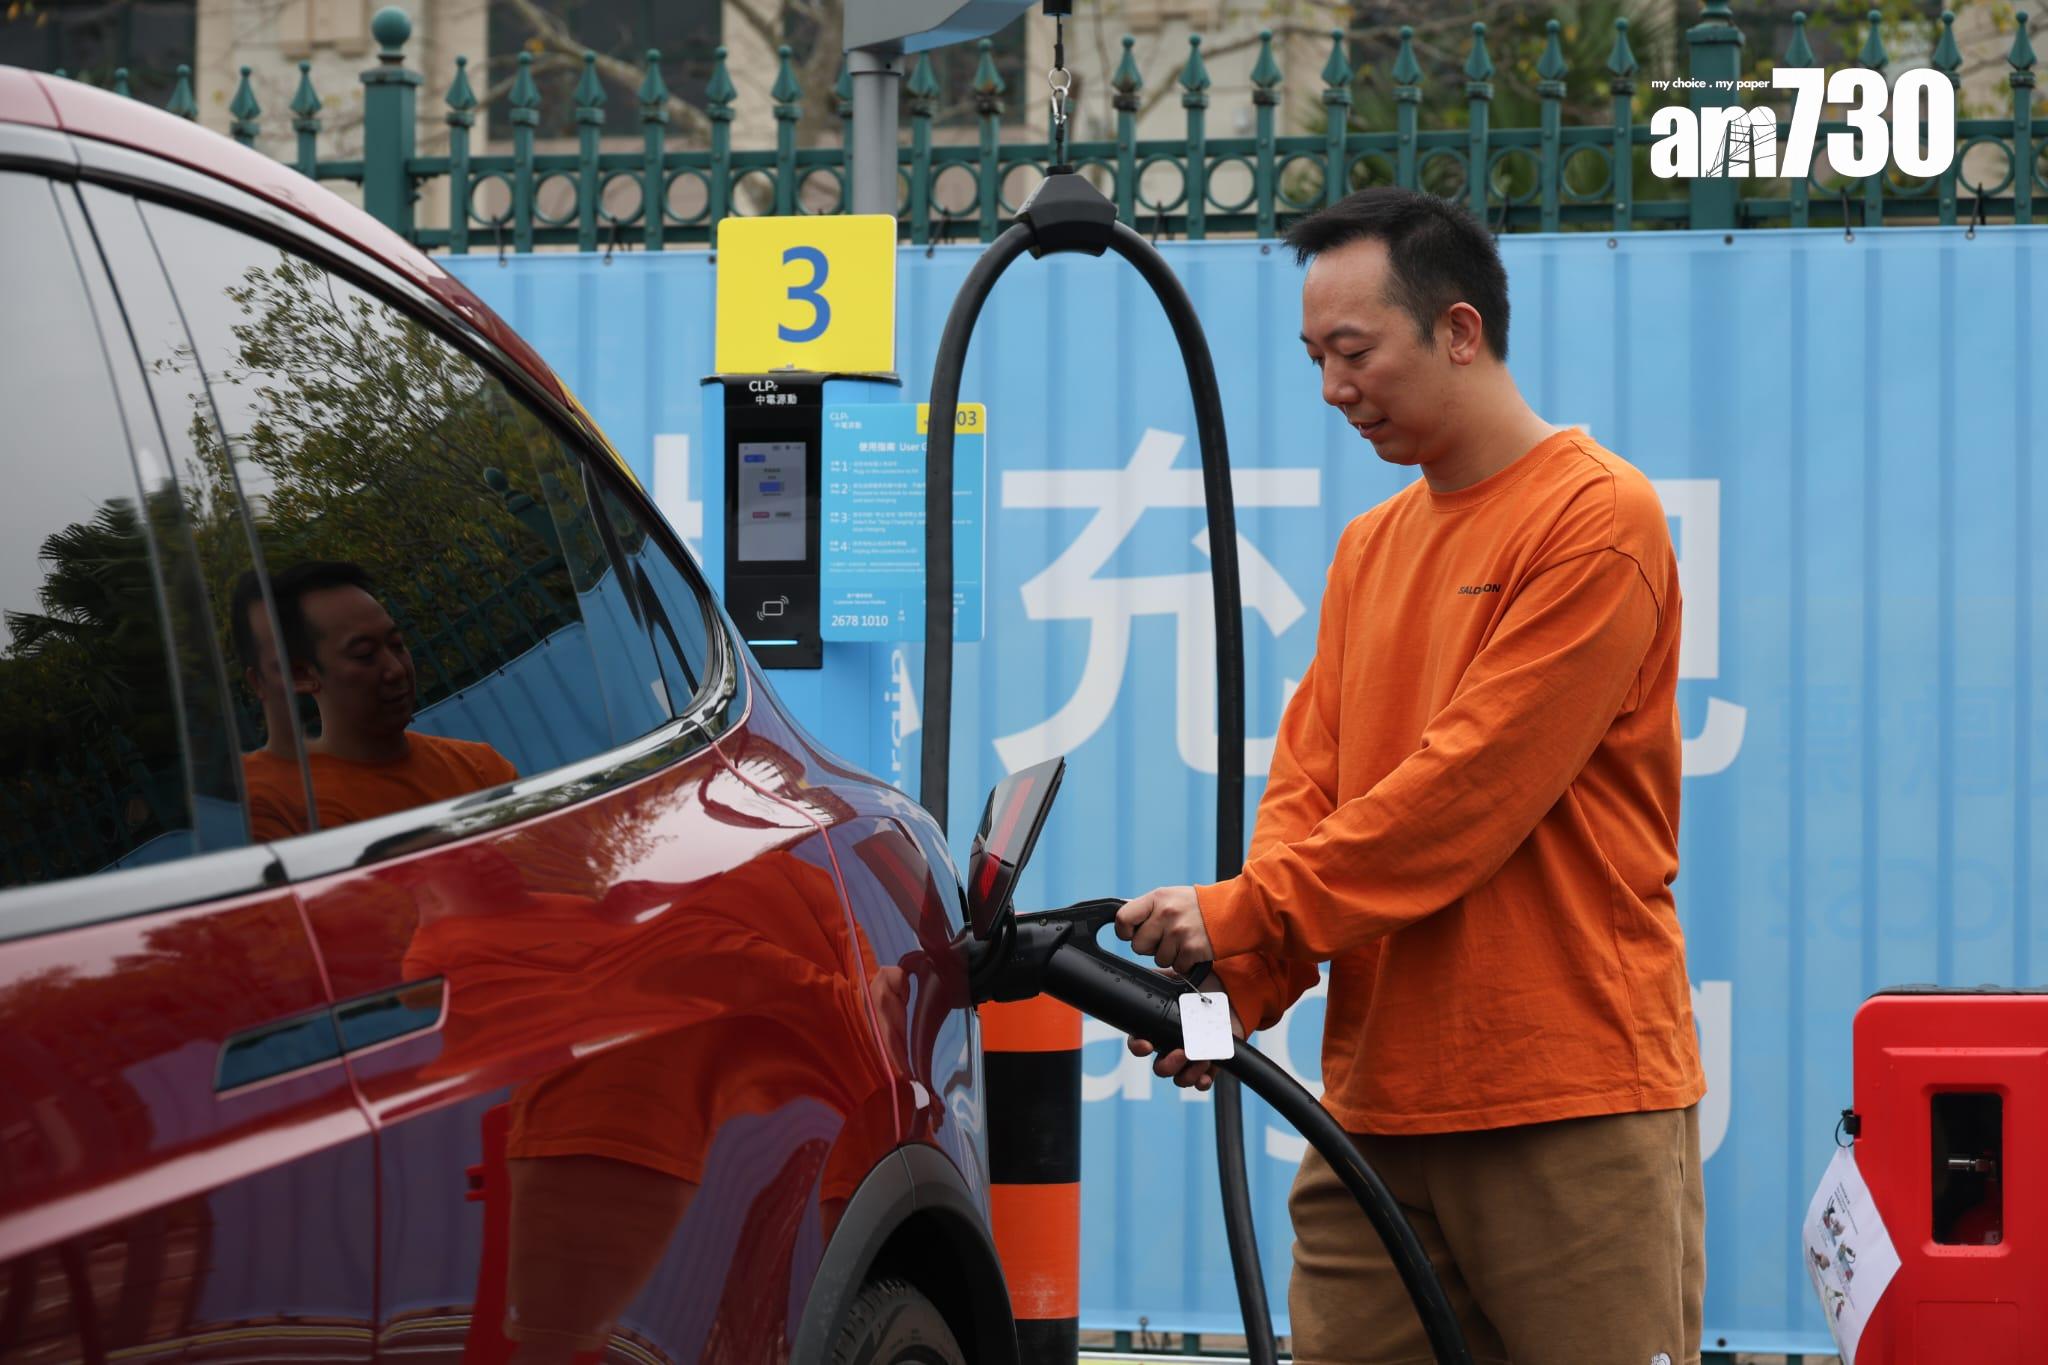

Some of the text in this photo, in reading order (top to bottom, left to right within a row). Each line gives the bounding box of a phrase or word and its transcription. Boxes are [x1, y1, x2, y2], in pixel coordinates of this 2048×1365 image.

[777, 246, 831, 343] 3
[1458, 583, 1501, 596] SALOON
[831, 615, 859, 627] 2678
[862, 615, 889, 627] 1010
